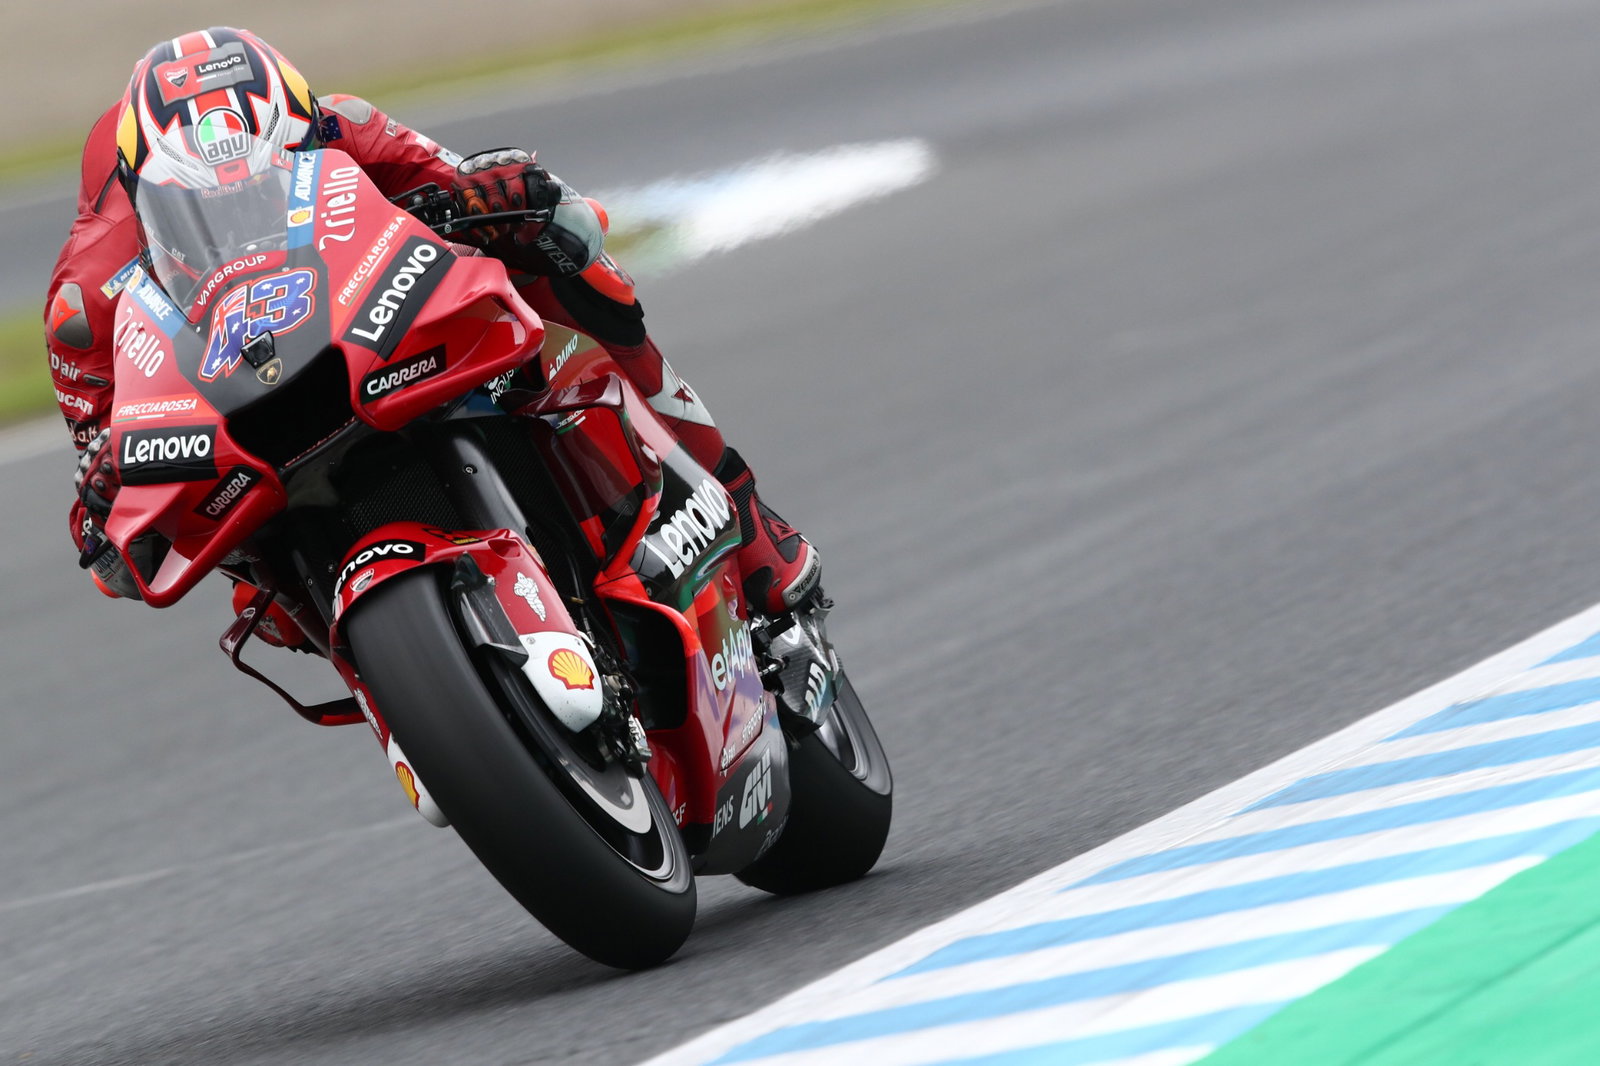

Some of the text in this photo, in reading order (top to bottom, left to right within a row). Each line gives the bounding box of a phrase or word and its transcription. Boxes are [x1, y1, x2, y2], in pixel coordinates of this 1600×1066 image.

[198, 56, 241, 74] Lenovo
[207, 134, 244, 162] agv
[197, 254, 267, 306] VARGROUP
[338, 215, 407, 307] FRECCIAROSSA
[351, 243, 437, 342] Lenovo
[199, 266, 318, 383] 43
[555, 334, 578, 371] DAIKO
[366, 356, 437, 395] CARRERA
[55, 387, 94, 415] UCATI
[116, 399, 198, 417] FRECCIAROSSA
[123, 434, 211, 464] Lenovo
[206, 472, 251, 516] CARRERA
[641, 479, 730, 580] Lenovo
[333, 544, 414, 602] enovo
[711, 620, 753, 691] etApp
